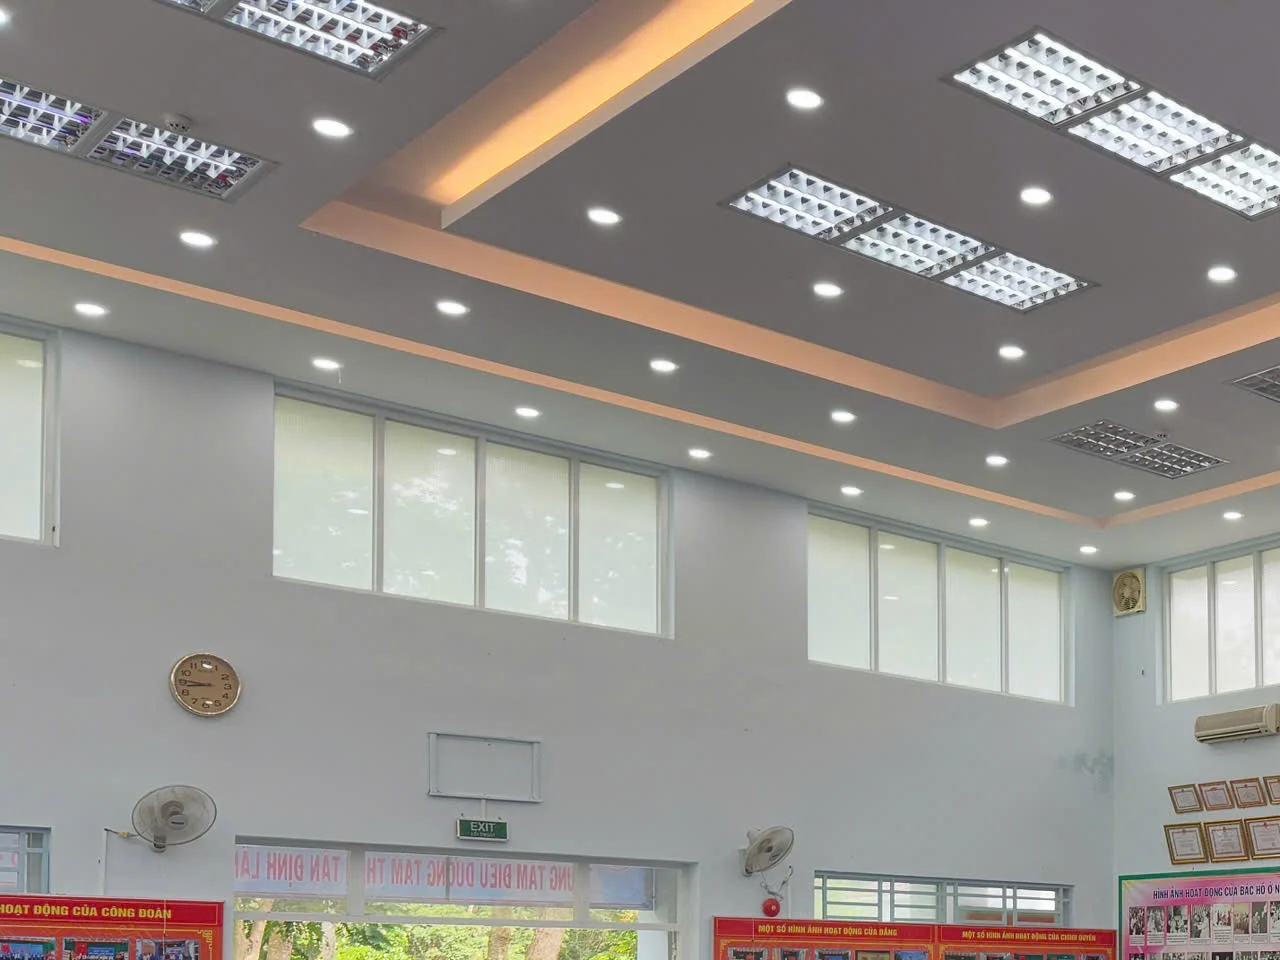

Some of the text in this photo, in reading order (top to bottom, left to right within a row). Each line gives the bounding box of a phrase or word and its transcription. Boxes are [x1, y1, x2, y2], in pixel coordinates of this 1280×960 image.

[471, 821, 496, 832] EXIT
[33, 903, 69, 918] ĐỘNG
[72, 904, 98, 917] CỦA
[101, 905, 136, 918] CÔNG
[758, 924, 774, 934] MỘT
